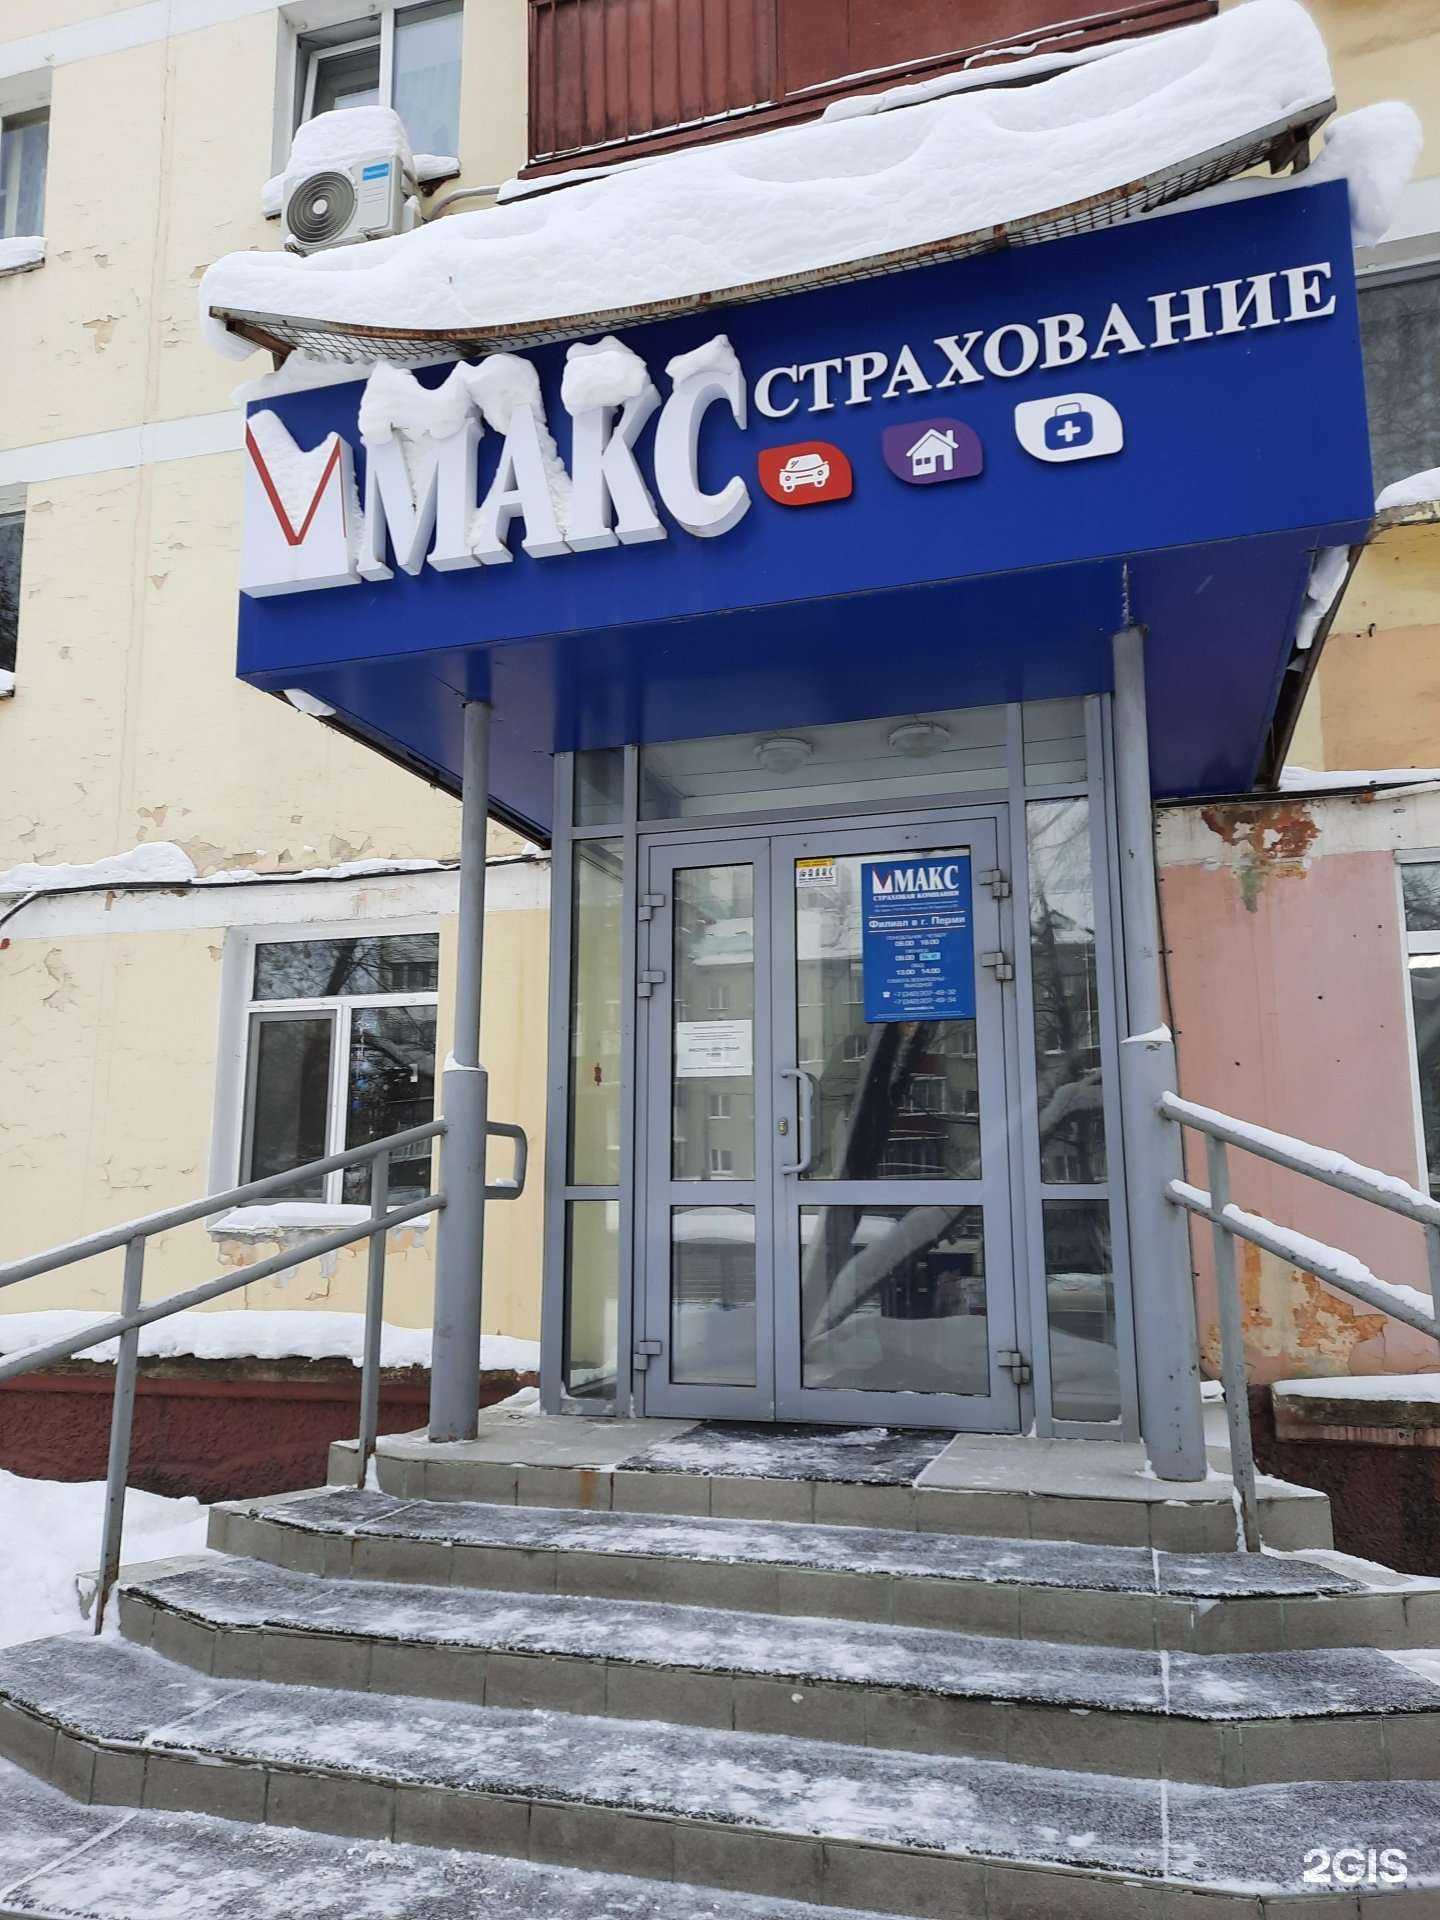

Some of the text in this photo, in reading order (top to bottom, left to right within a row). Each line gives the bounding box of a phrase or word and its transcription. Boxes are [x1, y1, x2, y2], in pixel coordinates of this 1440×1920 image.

[357, 261, 1337, 580] МАКС СТРАХОВАНИЕ
[894, 865, 959, 893] МАКС
[868, 919, 909, 928] Филиал
[931, 916, 966, 926] Перми
